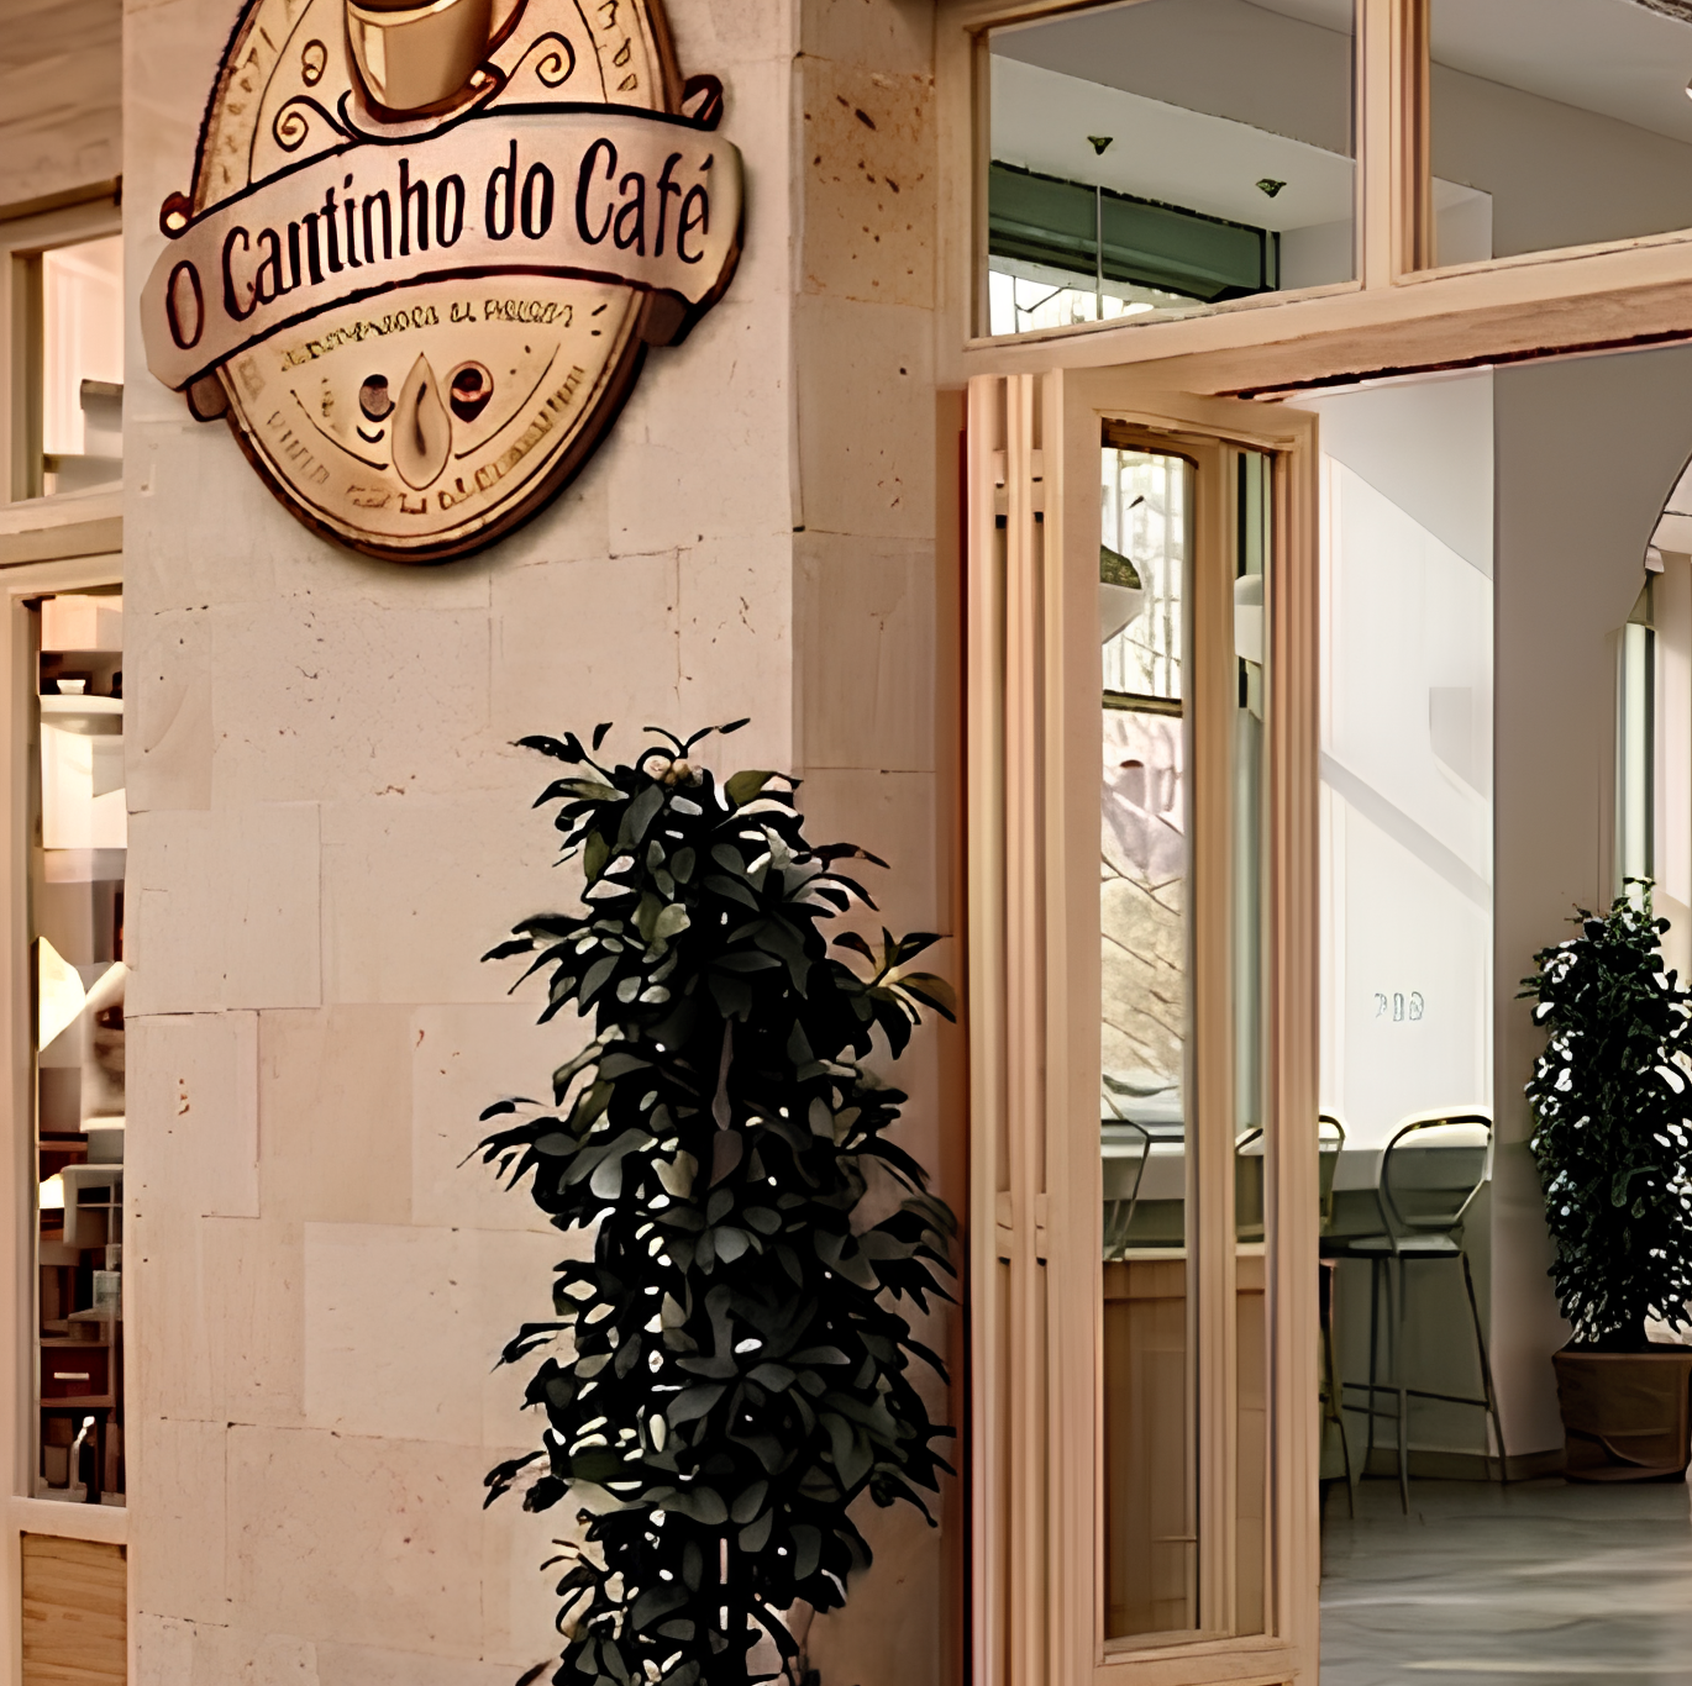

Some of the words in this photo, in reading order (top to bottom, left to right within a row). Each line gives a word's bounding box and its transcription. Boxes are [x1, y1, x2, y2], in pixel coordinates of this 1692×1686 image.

[165, 259, 205, 350] O
[221, 157, 466, 322] Cantinho
[484, 138, 555, 241] do
[574, 137, 714, 265] Café
